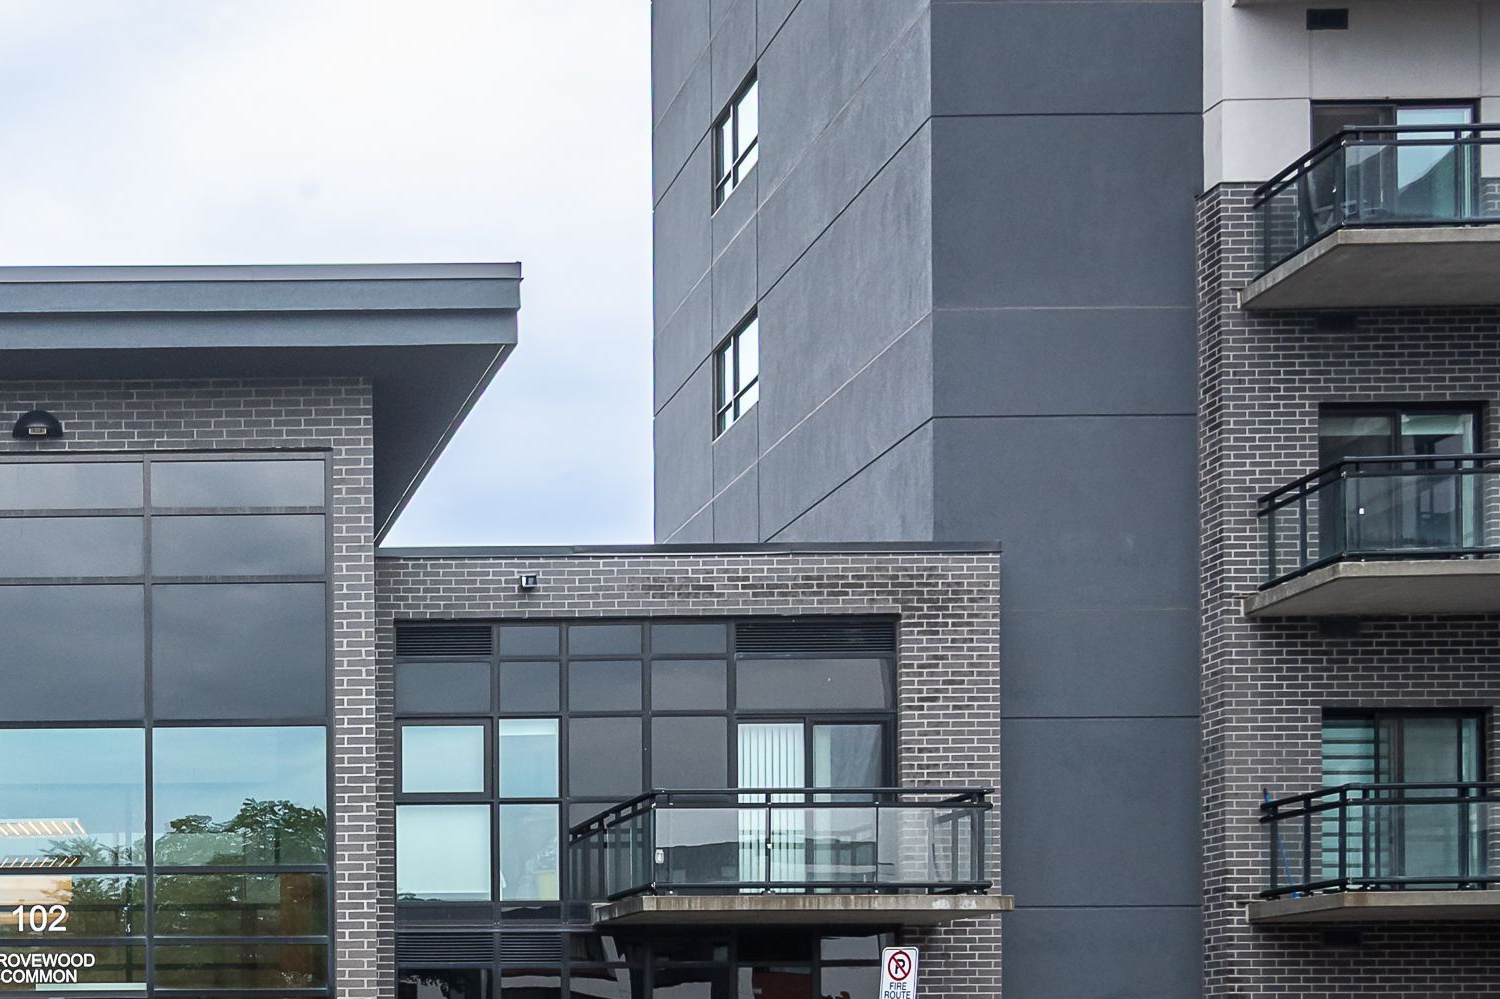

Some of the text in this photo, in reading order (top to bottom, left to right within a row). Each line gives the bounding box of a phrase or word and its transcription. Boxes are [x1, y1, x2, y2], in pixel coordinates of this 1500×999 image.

[12, 904, 67, 932] 102
[0, 969, 78, 984] COMMON
[889, 982, 907, 990] FIRE
[884, 991, 911, 999] ROUTE
